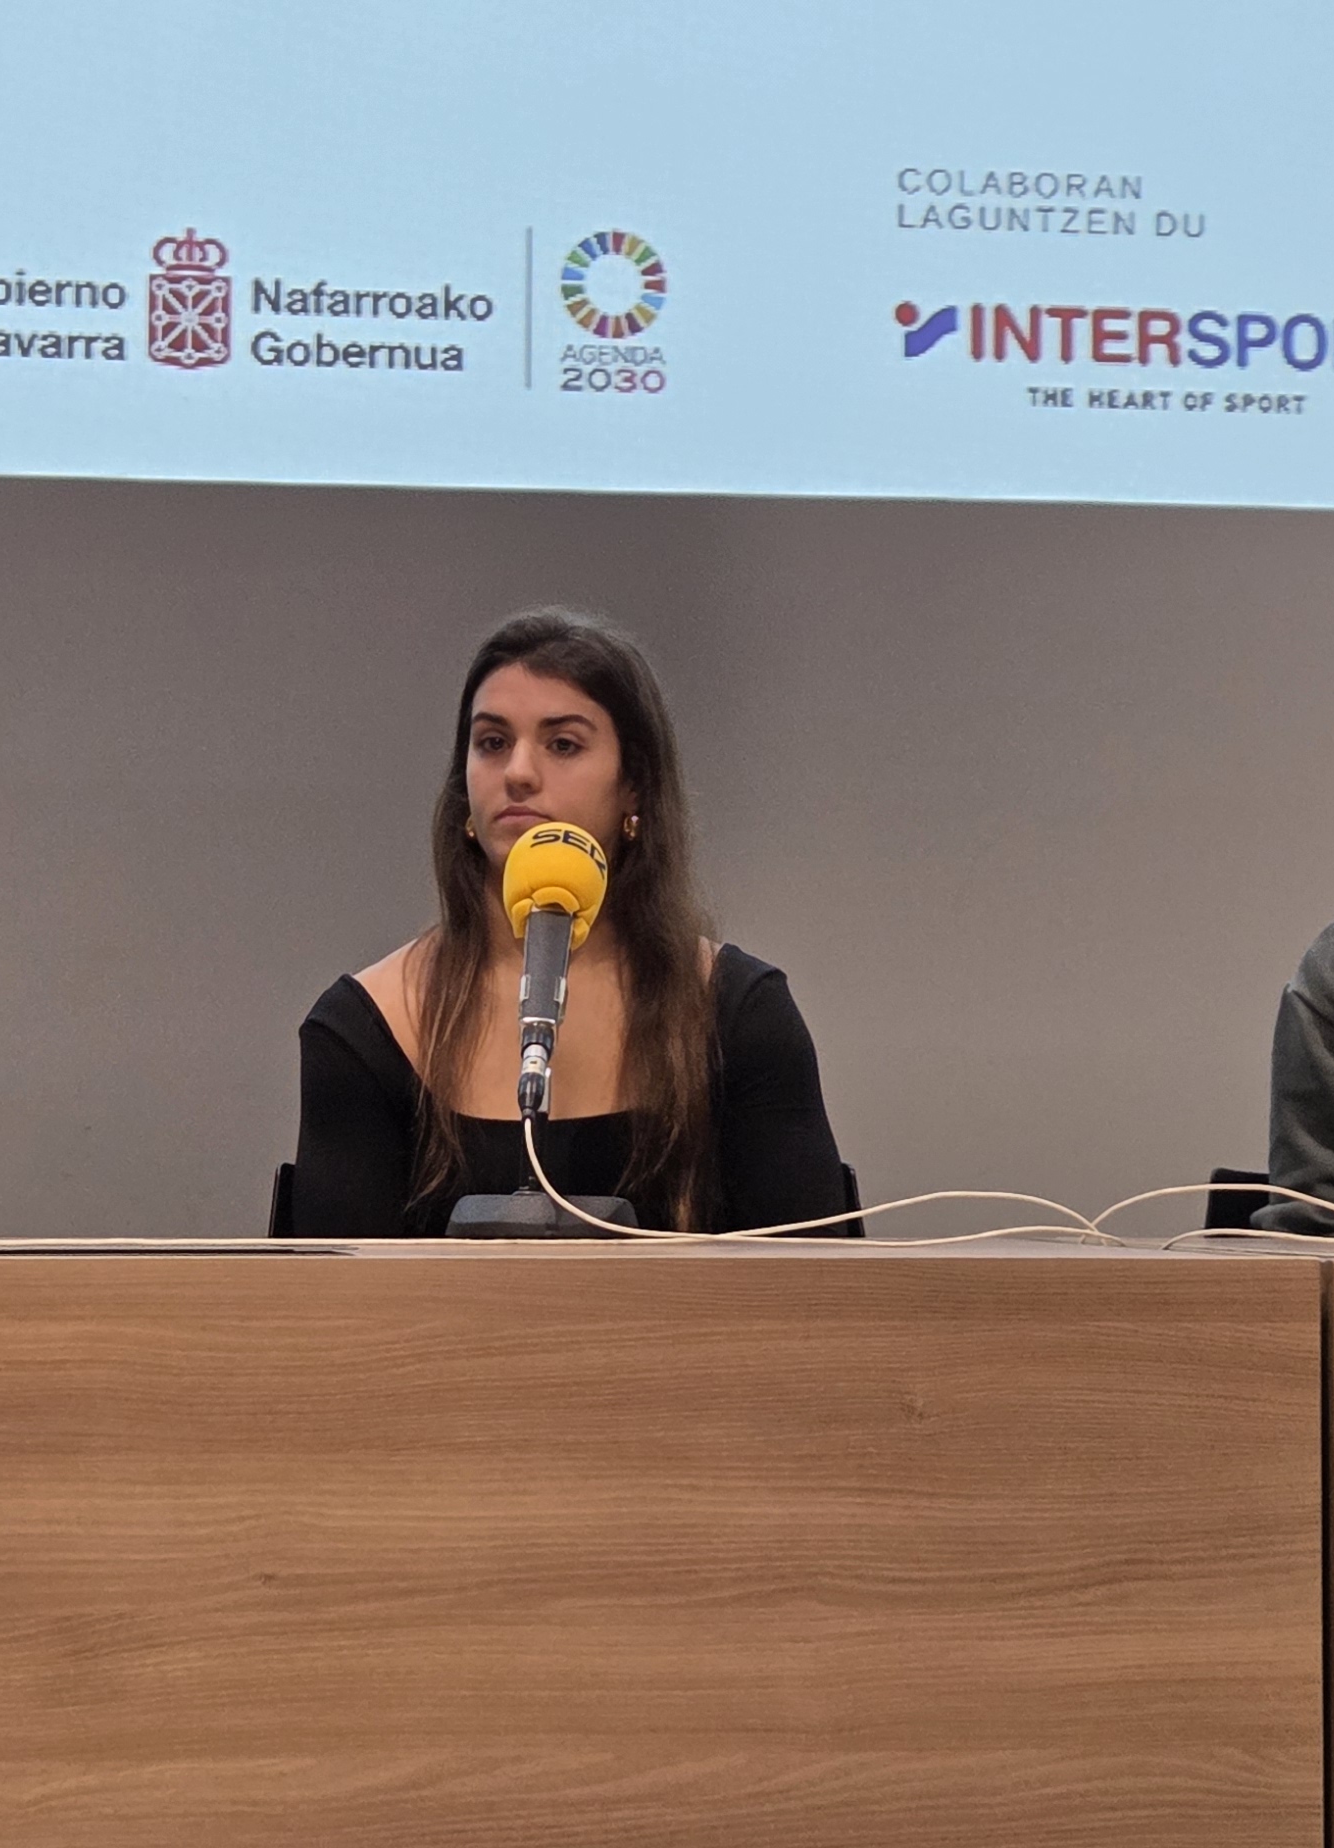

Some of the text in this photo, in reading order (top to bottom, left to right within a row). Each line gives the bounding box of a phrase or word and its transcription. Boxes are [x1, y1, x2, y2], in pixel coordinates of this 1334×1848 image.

[898, 168, 1142, 200] COLABORAN
[897, 203, 1205, 238] LAGUNTZEN DU
[251, 277, 494, 322] Nafarroako
[251, 331, 464, 371] Gobernua
[560, 344, 667, 366] AGENDA
[560, 368, 666, 393] 2030
[1027, 386, 1306, 415] THE HEART OF SPORT
[530, 828, 607, 881] SER
